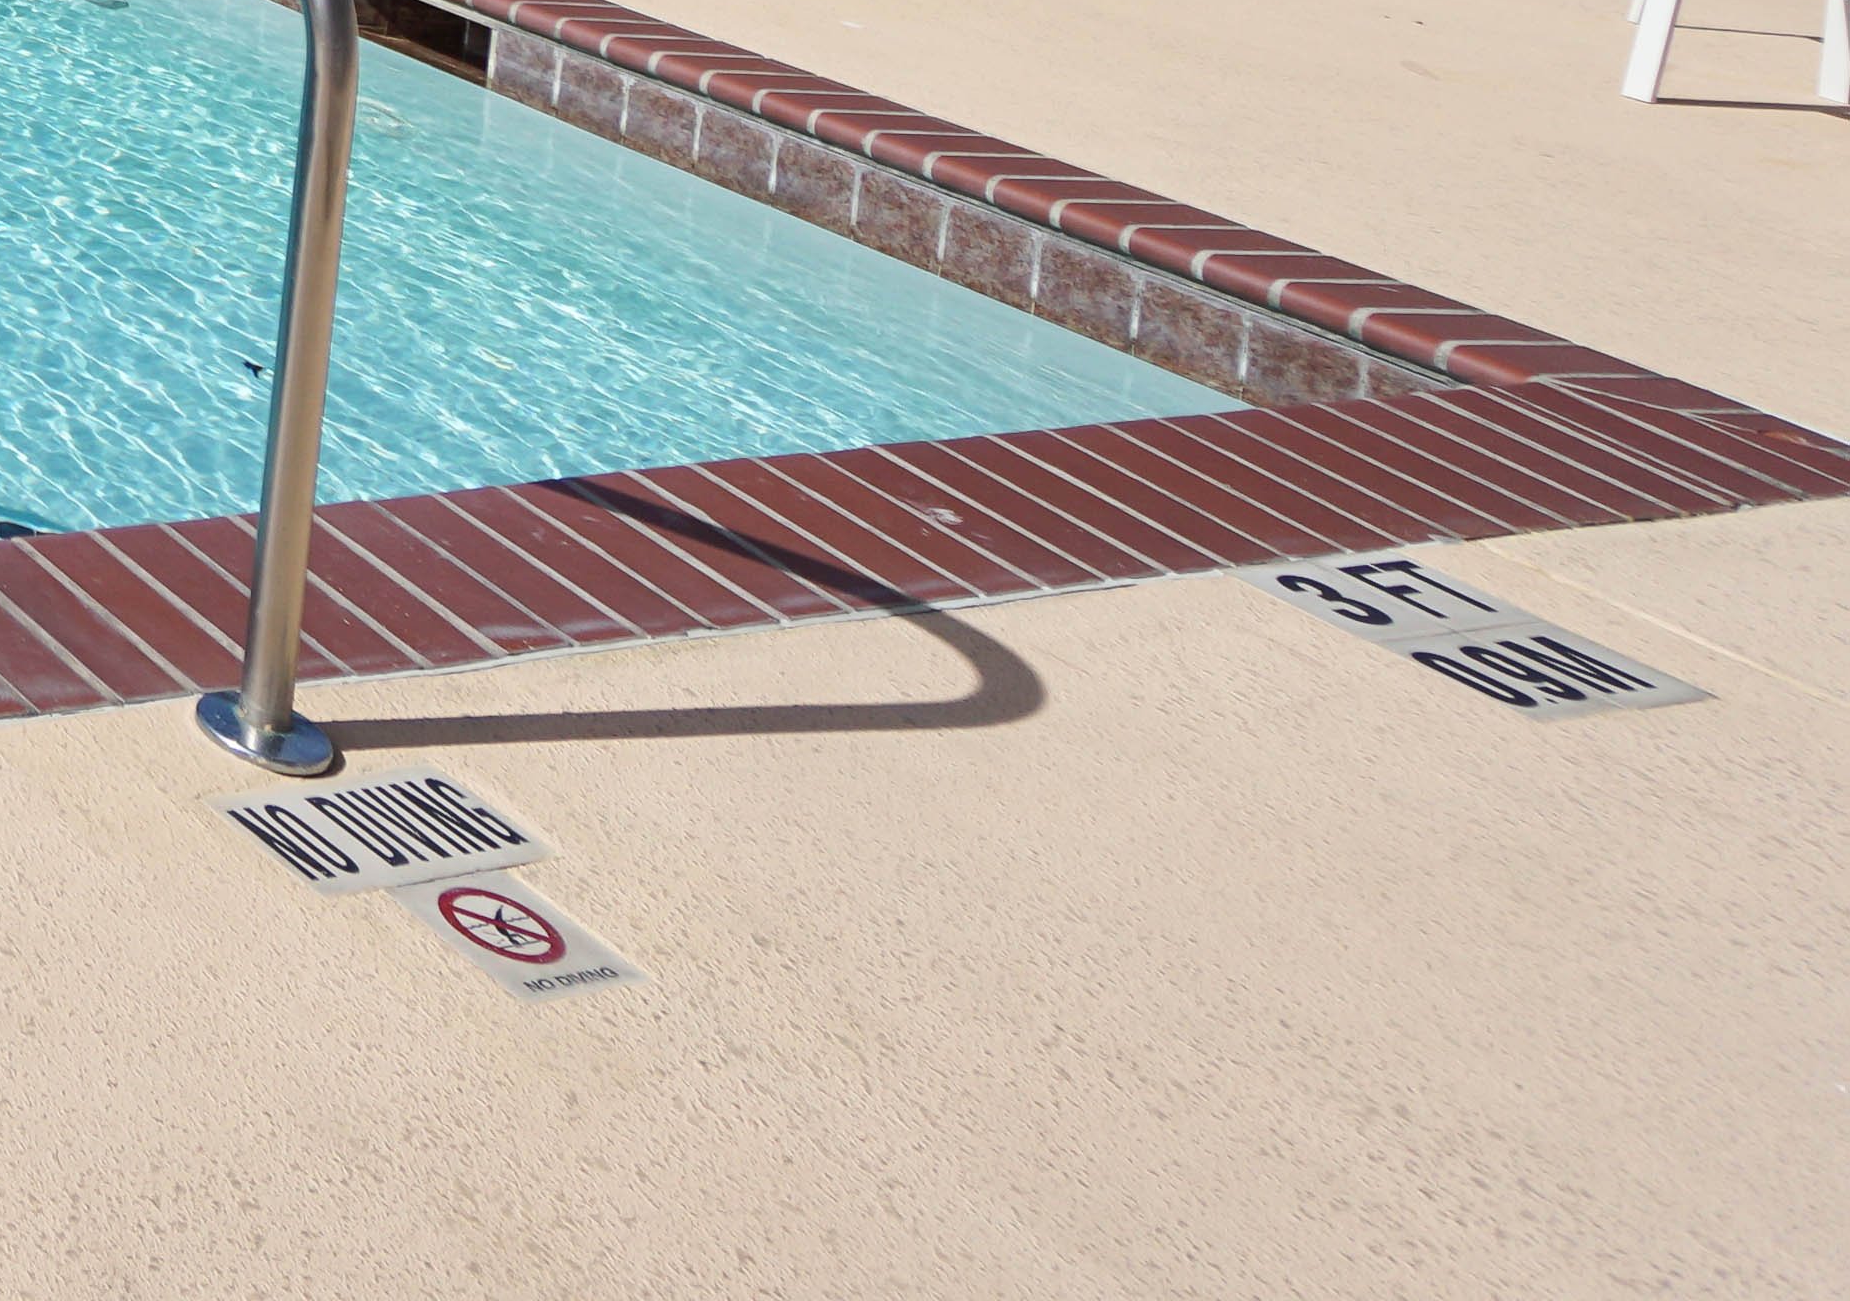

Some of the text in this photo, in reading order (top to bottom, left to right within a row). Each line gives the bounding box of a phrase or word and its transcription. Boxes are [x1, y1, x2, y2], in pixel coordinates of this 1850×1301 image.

[1276, 560, 1499, 626] 3 FT
[227, 777, 530, 881] NO DIVING
[523, 966, 619, 993] NO DIVING
